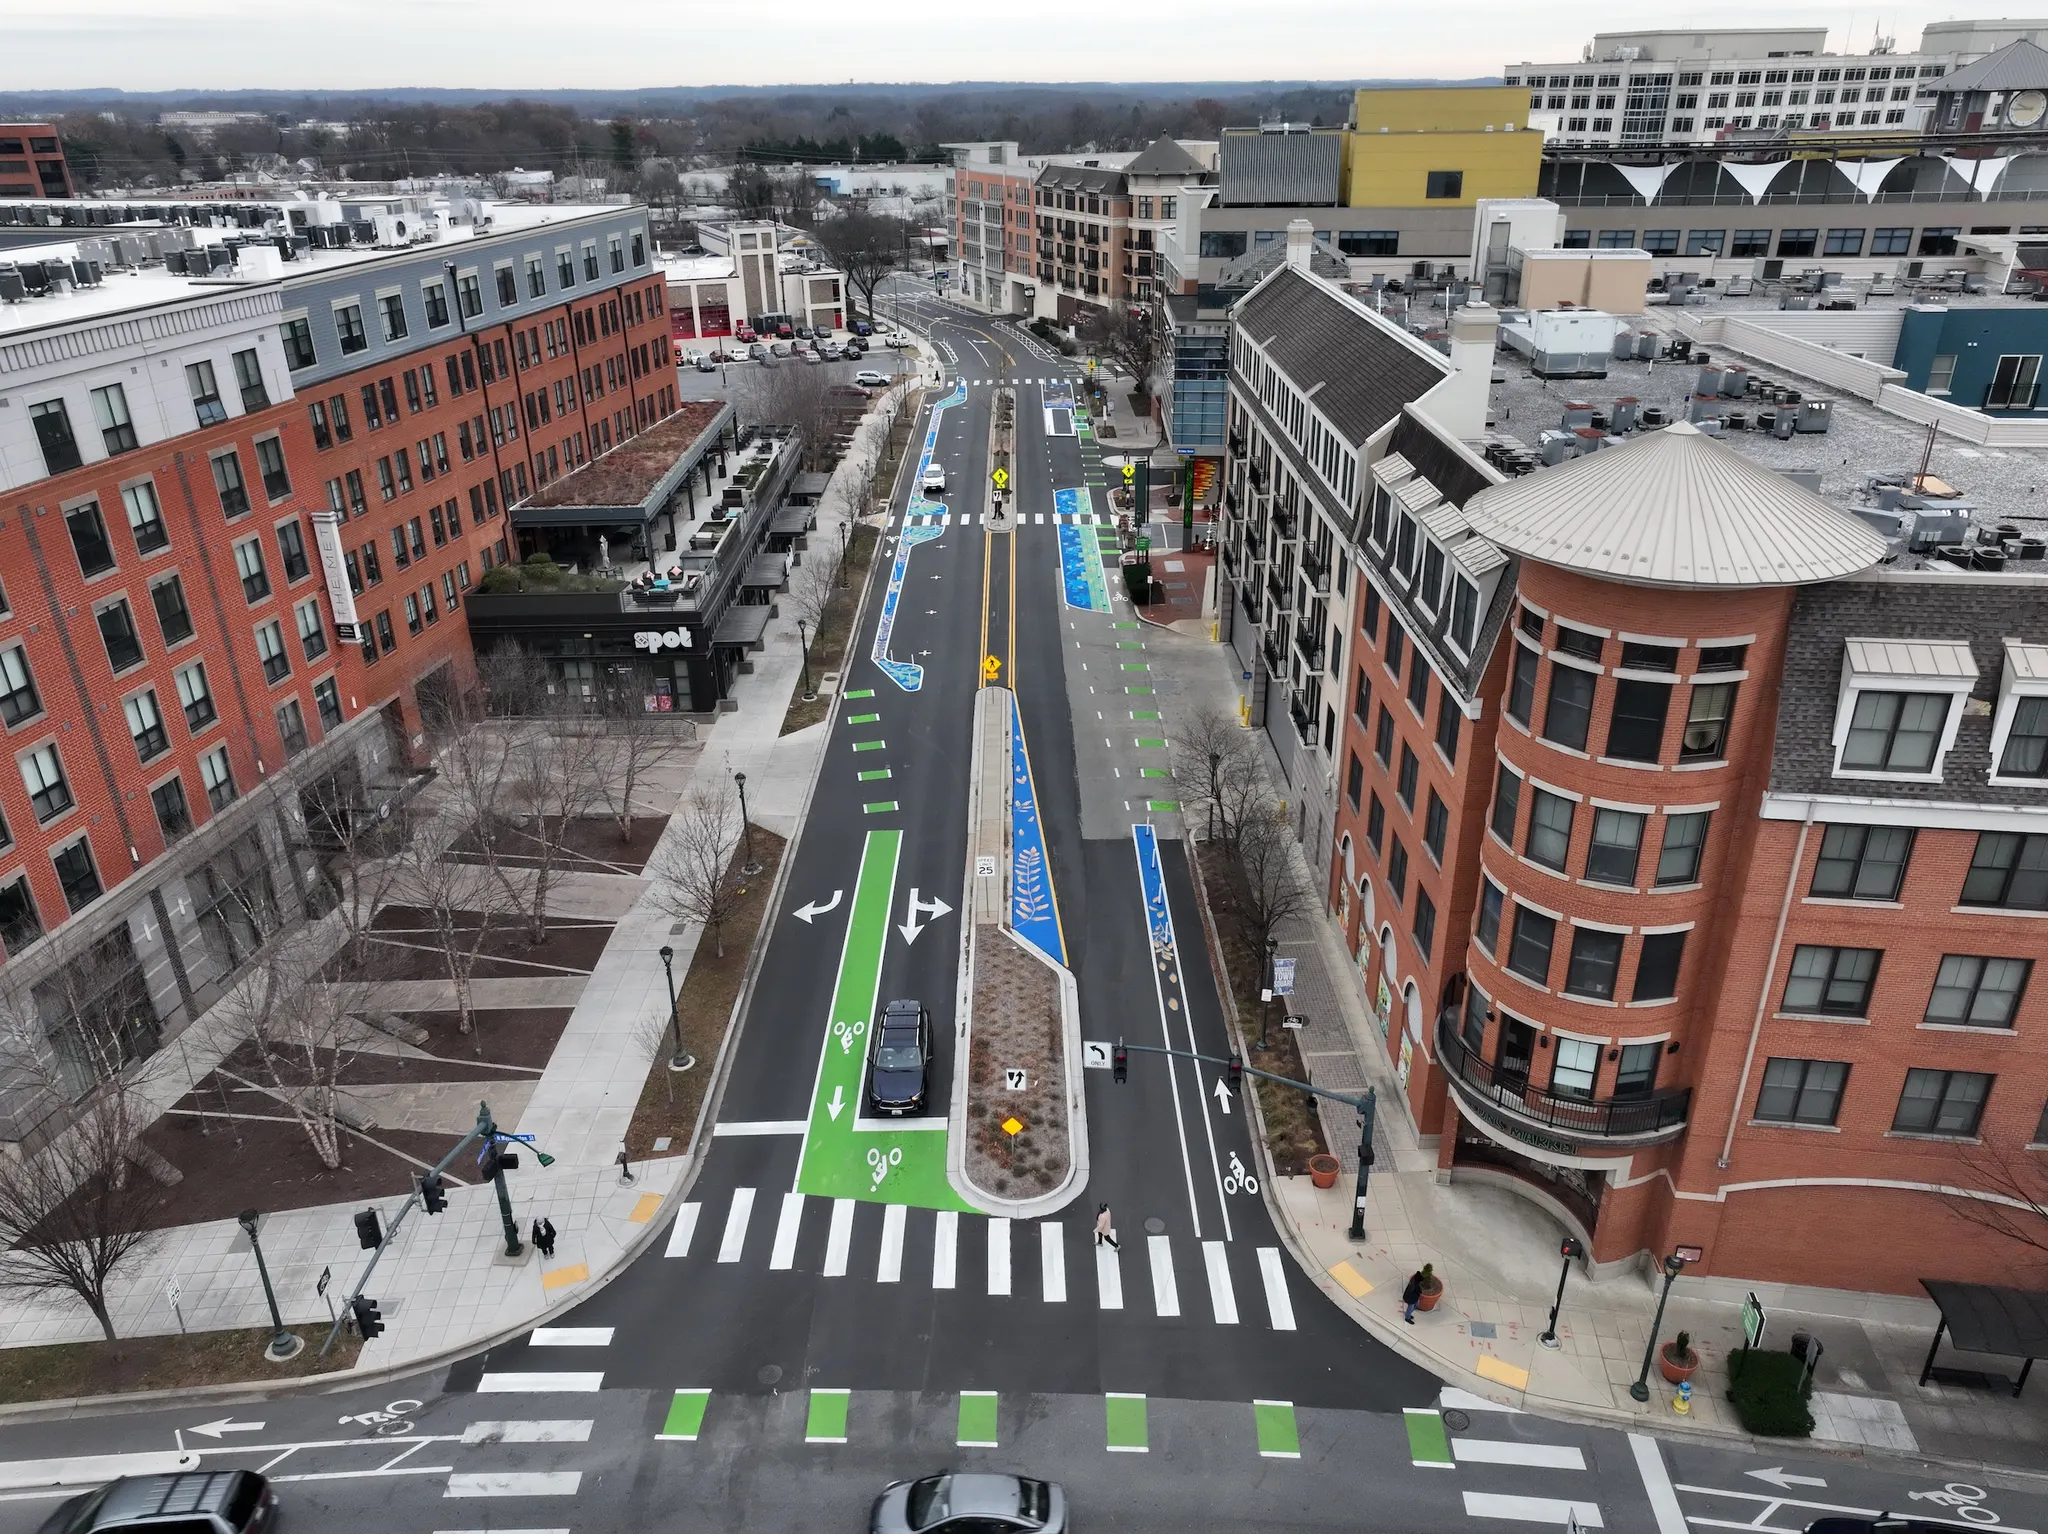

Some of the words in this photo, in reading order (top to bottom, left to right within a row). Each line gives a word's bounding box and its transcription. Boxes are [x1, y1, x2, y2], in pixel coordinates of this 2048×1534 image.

[319, 527, 338, 569] MET
[978, 866, 994, 875] 25
[1510, 1126, 1578, 1157] MARKET
